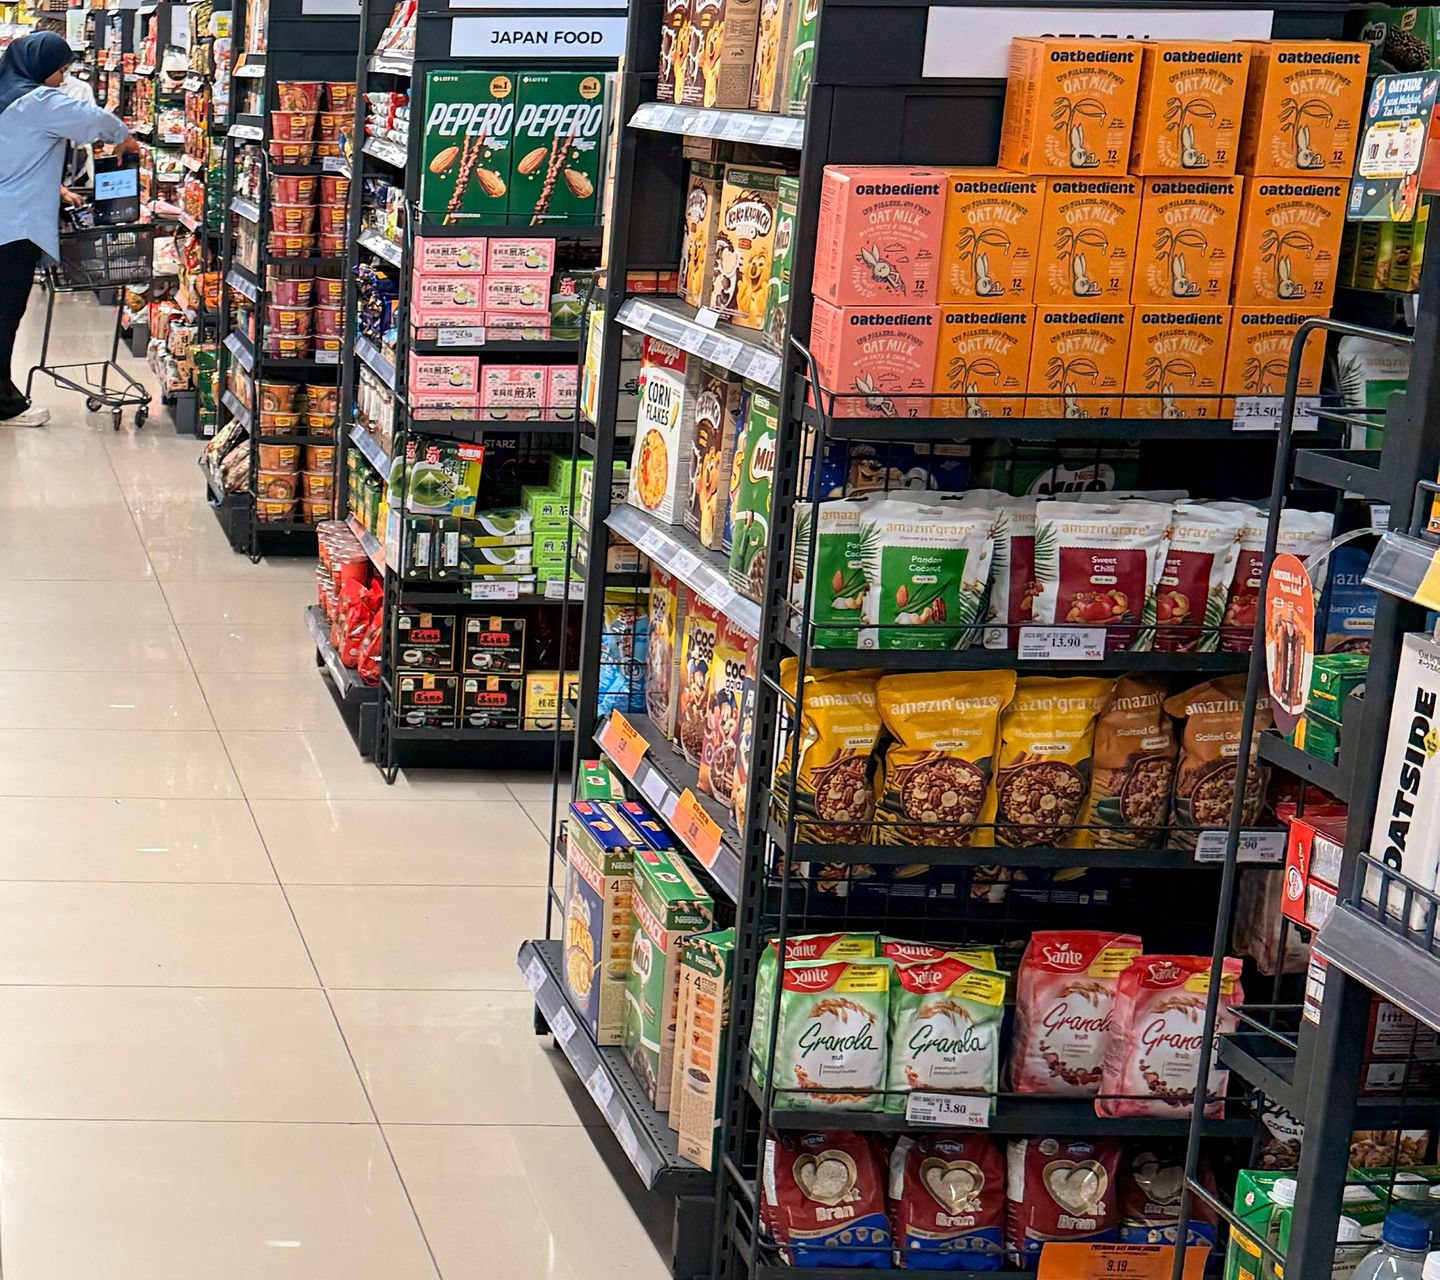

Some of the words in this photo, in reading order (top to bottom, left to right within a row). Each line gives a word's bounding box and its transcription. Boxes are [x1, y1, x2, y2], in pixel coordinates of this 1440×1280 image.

[491, 30, 548, 45] JAPAN
[554, 30, 603, 45] FOOD
[1050, 49, 1135, 65] oatbedient
[1163, 49, 1244, 65] oatbedient
[1278, 51, 1362, 66] oatbedient
[427, 102, 515, 137] PEPERO
[515, 103, 603, 138] PEPERO
[856, 182, 940, 197] oatbedient
[954, 180, 1037, 195] oatbedient
[1052, 180, 1136, 195] oatbedient
[1151, 181, 1235, 195] oatbedient
[1259, 183, 1342, 198] oatbedient
[850, 313, 933, 328] oatbedient
[945, 311, 1027, 326] oatbedient
[1043, 311, 1125, 326] oatbedient
[647, 382, 671, 410] CORN
[1246, 406, 1278, 418] 23.50
[1090, 555, 1118, 565] Sweet
[1050, 636, 1081, 649] 13.90
[798, 1022, 879, 1059] Granola
[909, 1023, 987, 1059] Granola
[938, 1102, 967, 1115] 13.80
[815, 1204, 856, 1221] Bran
